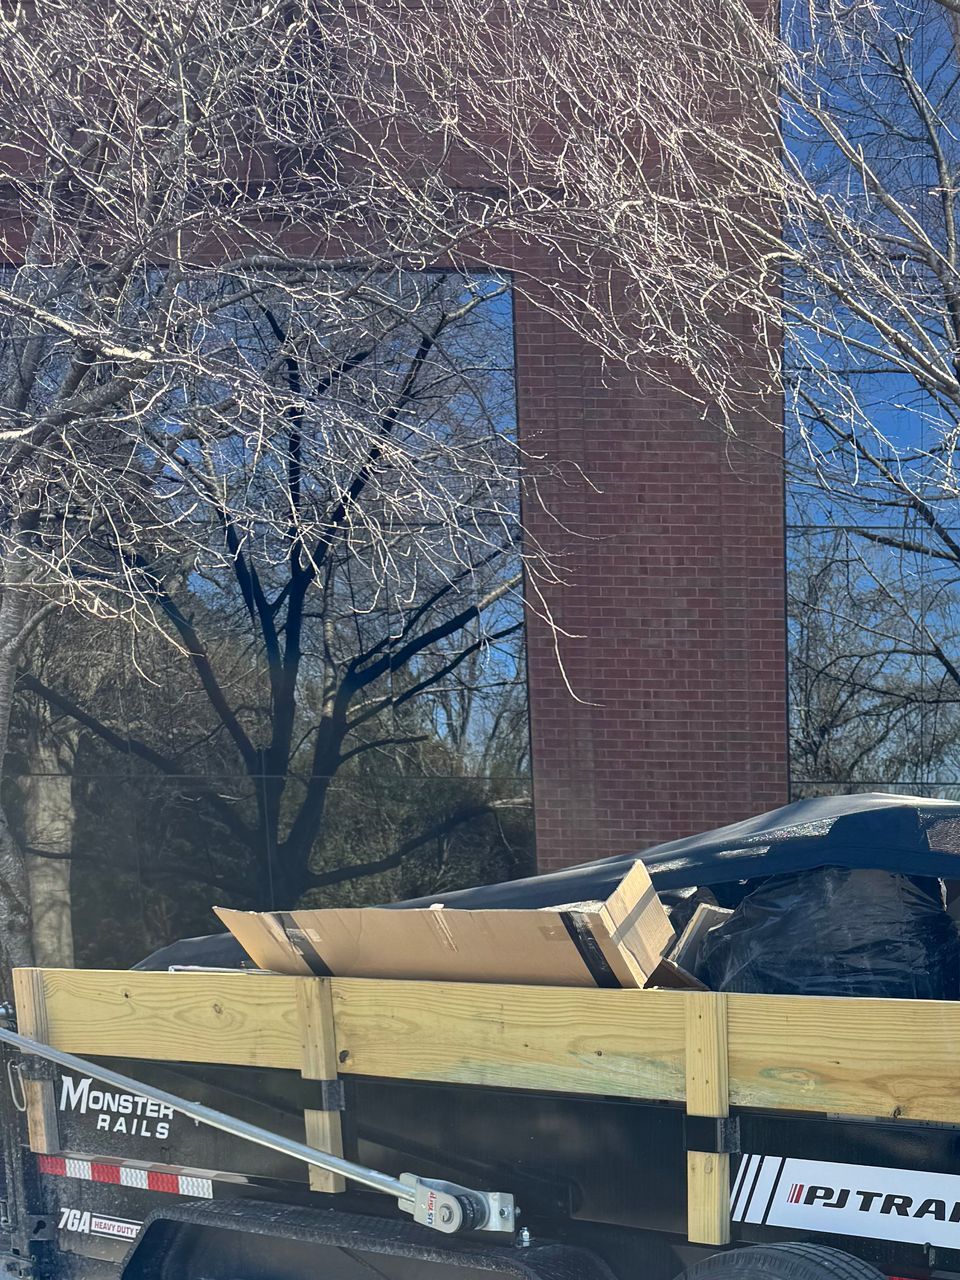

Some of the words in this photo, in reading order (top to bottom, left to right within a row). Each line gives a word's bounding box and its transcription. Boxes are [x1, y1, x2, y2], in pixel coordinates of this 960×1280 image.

[60, 1074, 175, 1120] MONSTER
[96, 1114, 170, 1139] RAILS
[803, 1185, 851, 1210] PJ
[58, 1207, 91, 1234] 7GA
[94, 1220, 116, 1233] HEAVY
[117, 1224, 135, 1236] DUTY
